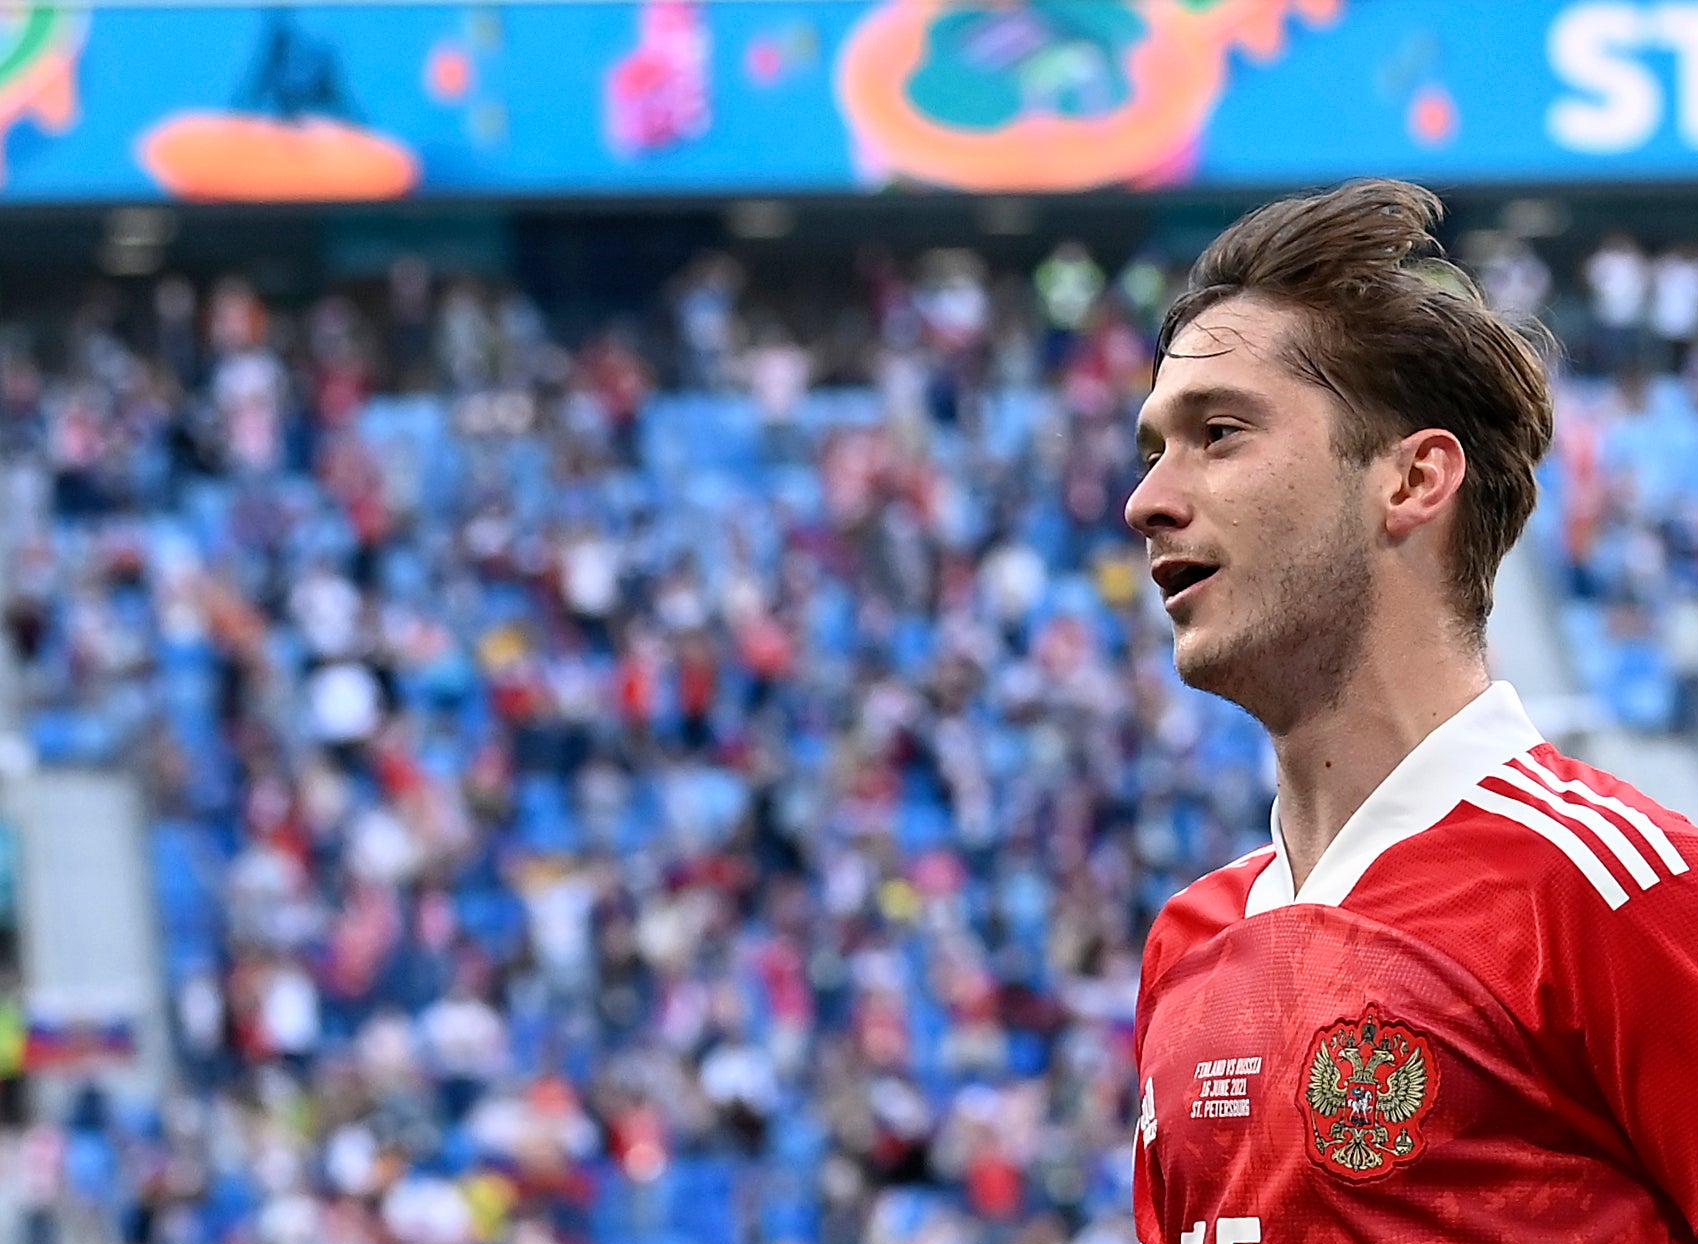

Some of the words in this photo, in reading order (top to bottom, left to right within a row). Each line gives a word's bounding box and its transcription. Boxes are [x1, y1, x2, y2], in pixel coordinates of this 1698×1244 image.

[1210, 1078, 1231, 1097] JUNE
[1230, 1077, 1247, 1096] 2021
[1204, 1099, 1250, 1118] PETERSBURG
